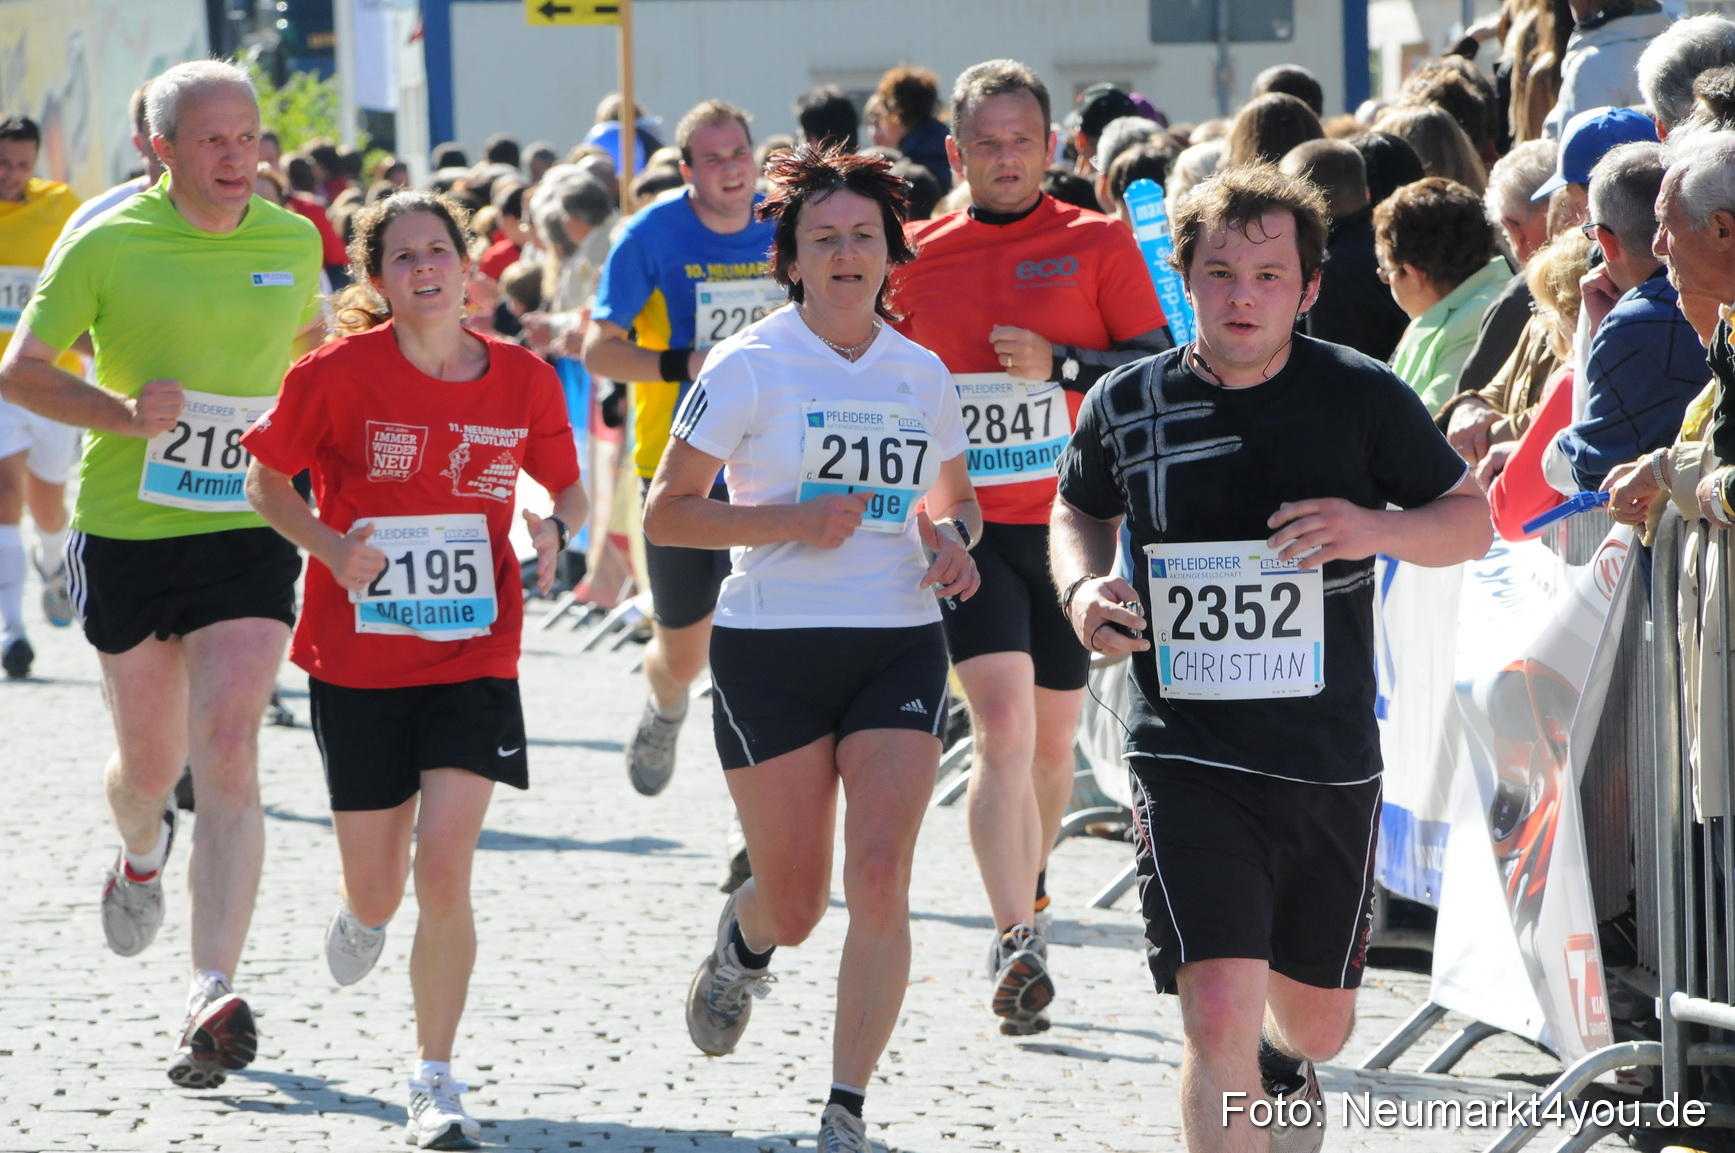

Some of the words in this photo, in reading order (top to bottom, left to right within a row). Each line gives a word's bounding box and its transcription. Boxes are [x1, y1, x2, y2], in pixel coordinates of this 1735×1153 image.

[1015, 256, 1079, 280] eco
[1153, 247, 1188, 345] axi-dsl.de
[183, 401, 236, 417] FLEIDERER
[826, 410, 884, 425] PFLEIDERER
[448, 423, 463, 433] 11.
[962, 397, 1052, 444] 2847
[163, 421, 250, 470] 218
[374, 431, 417, 445] IMMER
[462, 433, 519, 448] STADTLAUF
[372, 442, 418, 456] WIEDER
[373, 453, 413, 470] NEU
[818, 434, 928, 486] 2167
[177, 470, 243, 496] Armin
[374, 527, 430, 540] FLEIDERER
[368, 549, 477, 597] 2195
[1168, 555, 1241, 571] PFLEIDERER
[1169, 571, 1242, 580] AKTIENGESELLSCHAFT
[376, 601, 475, 625] Melanie
[1168, 582, 1302, 641] 2352
[1172, 651, 1306, 683] CHRISTIAN
